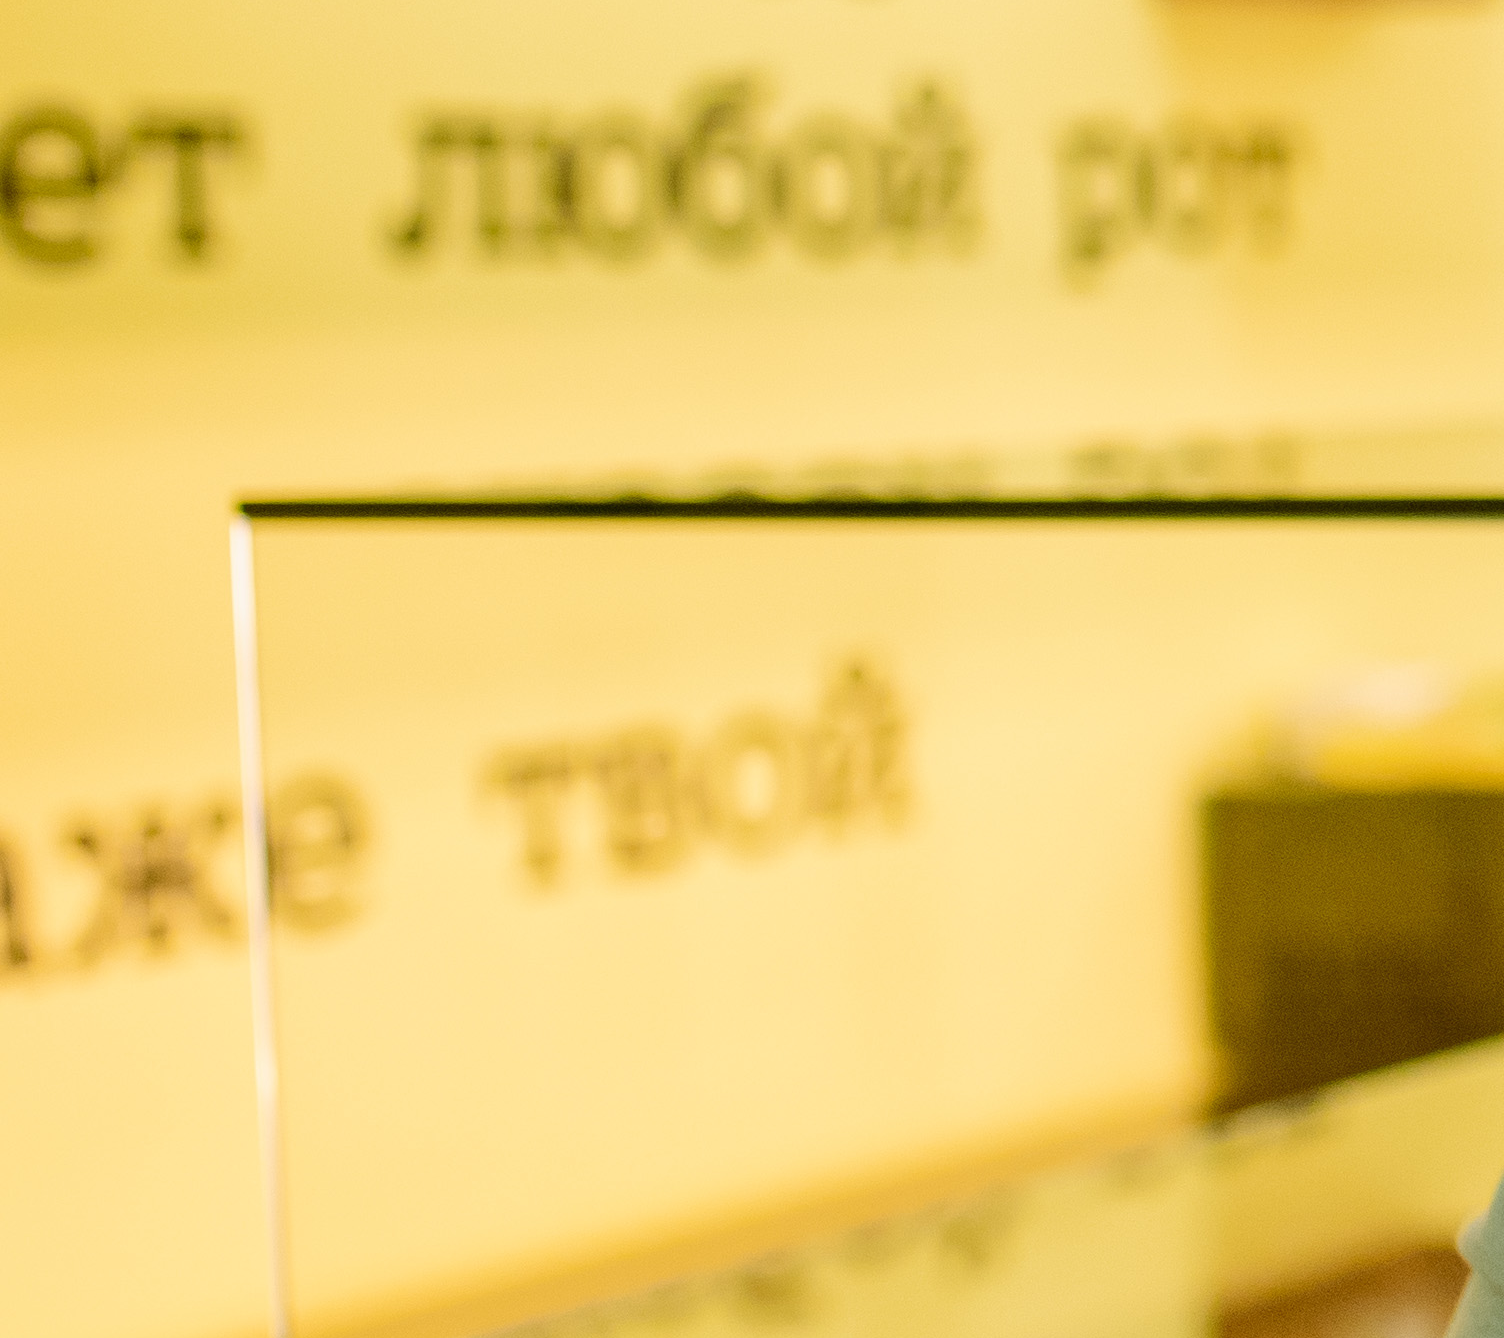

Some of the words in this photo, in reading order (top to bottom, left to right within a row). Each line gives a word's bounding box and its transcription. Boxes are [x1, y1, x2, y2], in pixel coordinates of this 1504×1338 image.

[0, 99, 252, 263] ет
[386, 71, 978, 267] любой
[1056, 113, 1306, 289] рот
[482, 651, 915, 889] твой
